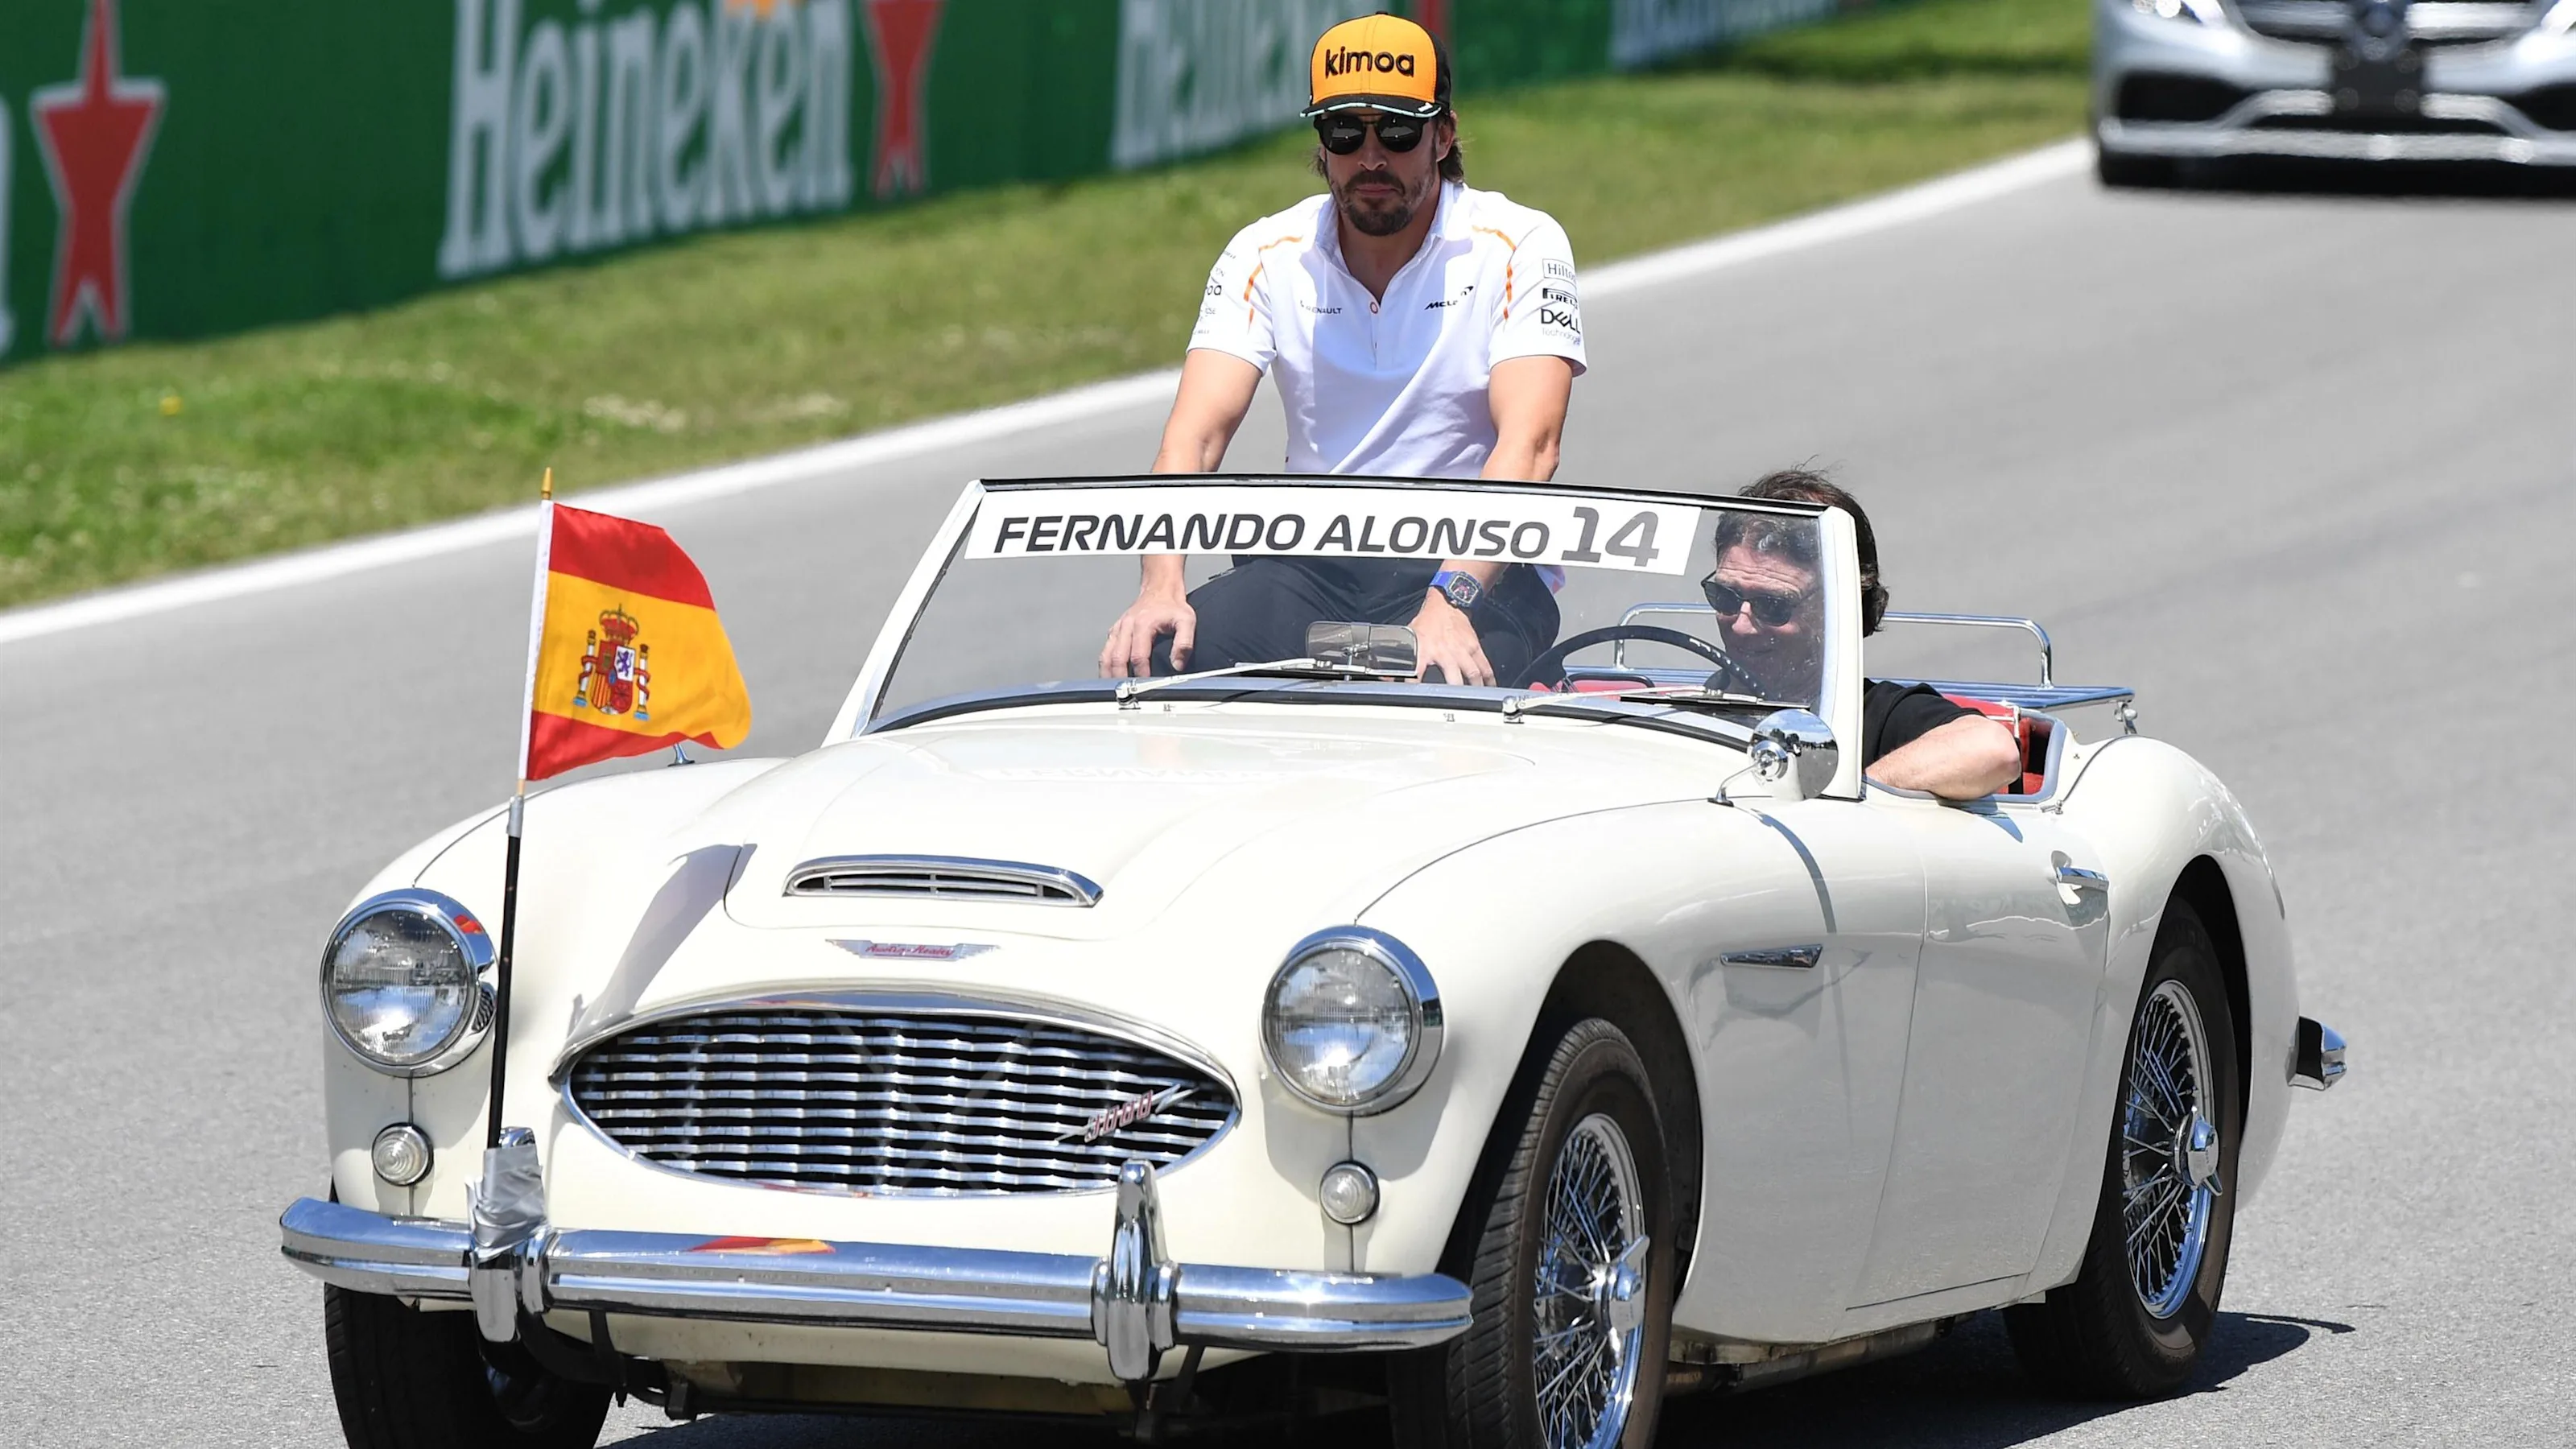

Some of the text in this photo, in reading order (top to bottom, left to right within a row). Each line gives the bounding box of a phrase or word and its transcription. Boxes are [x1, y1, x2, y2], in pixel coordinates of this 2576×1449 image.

[1324, 46, 1415, 79] kimoa
[436, 0, 852, 279] Heineken
[1541, 308, 1580, 334] DELL
[993, 506, 1661, 568] FERNANDO ALONSO 14
[1084, 1089, 1154, 1143] 3000
